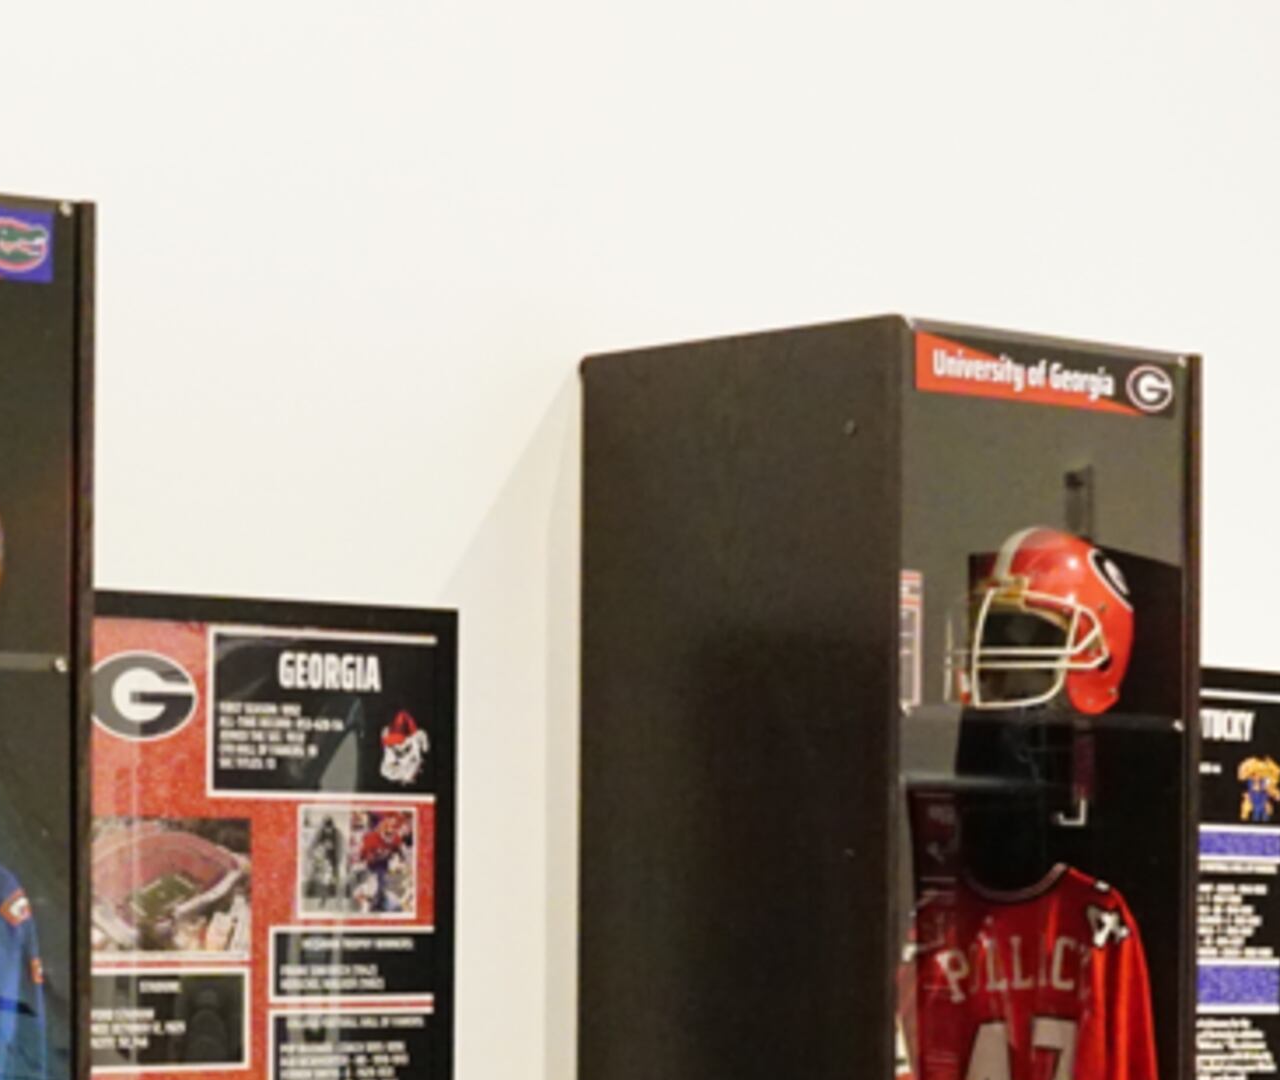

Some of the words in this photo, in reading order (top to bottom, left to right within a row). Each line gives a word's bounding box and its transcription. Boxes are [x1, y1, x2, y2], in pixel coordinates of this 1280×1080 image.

[932, 348, 1025, 392] University
[1028, 359, 1047, 386] of
[1049, 362, 1115, 401] Georgia
[278, 651, 381, 692] GEORGIA
